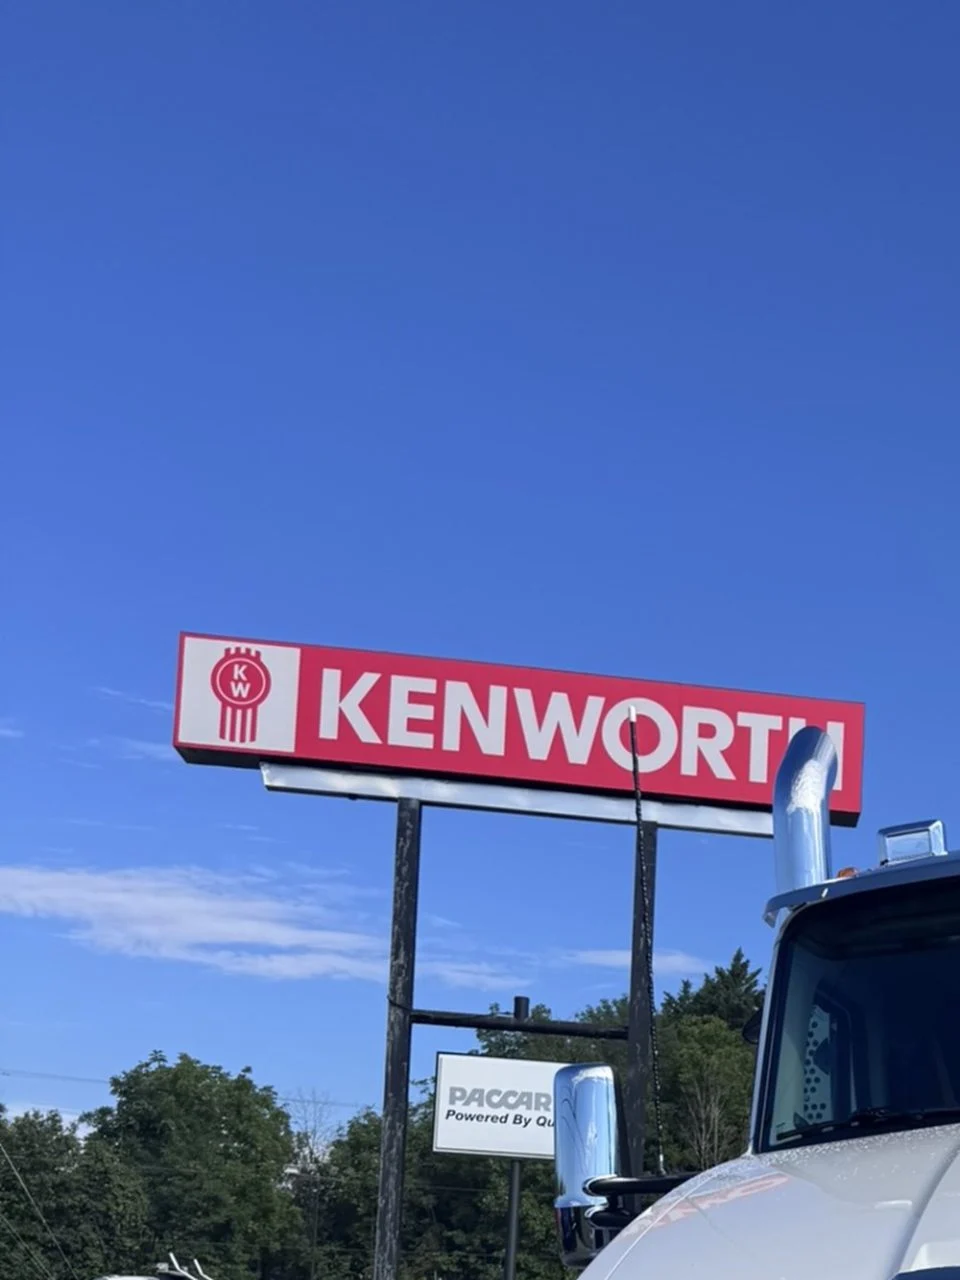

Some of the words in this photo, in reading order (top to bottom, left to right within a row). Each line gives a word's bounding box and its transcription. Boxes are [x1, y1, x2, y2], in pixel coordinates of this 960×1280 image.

[233, 664, 248, 681] K
[230, 681, 251, 698] W
[449, 1086, 552, 1112] PACCAR
[445, 1109, 509, 1124] Powered
[512, 1114, 532, 1128] By
